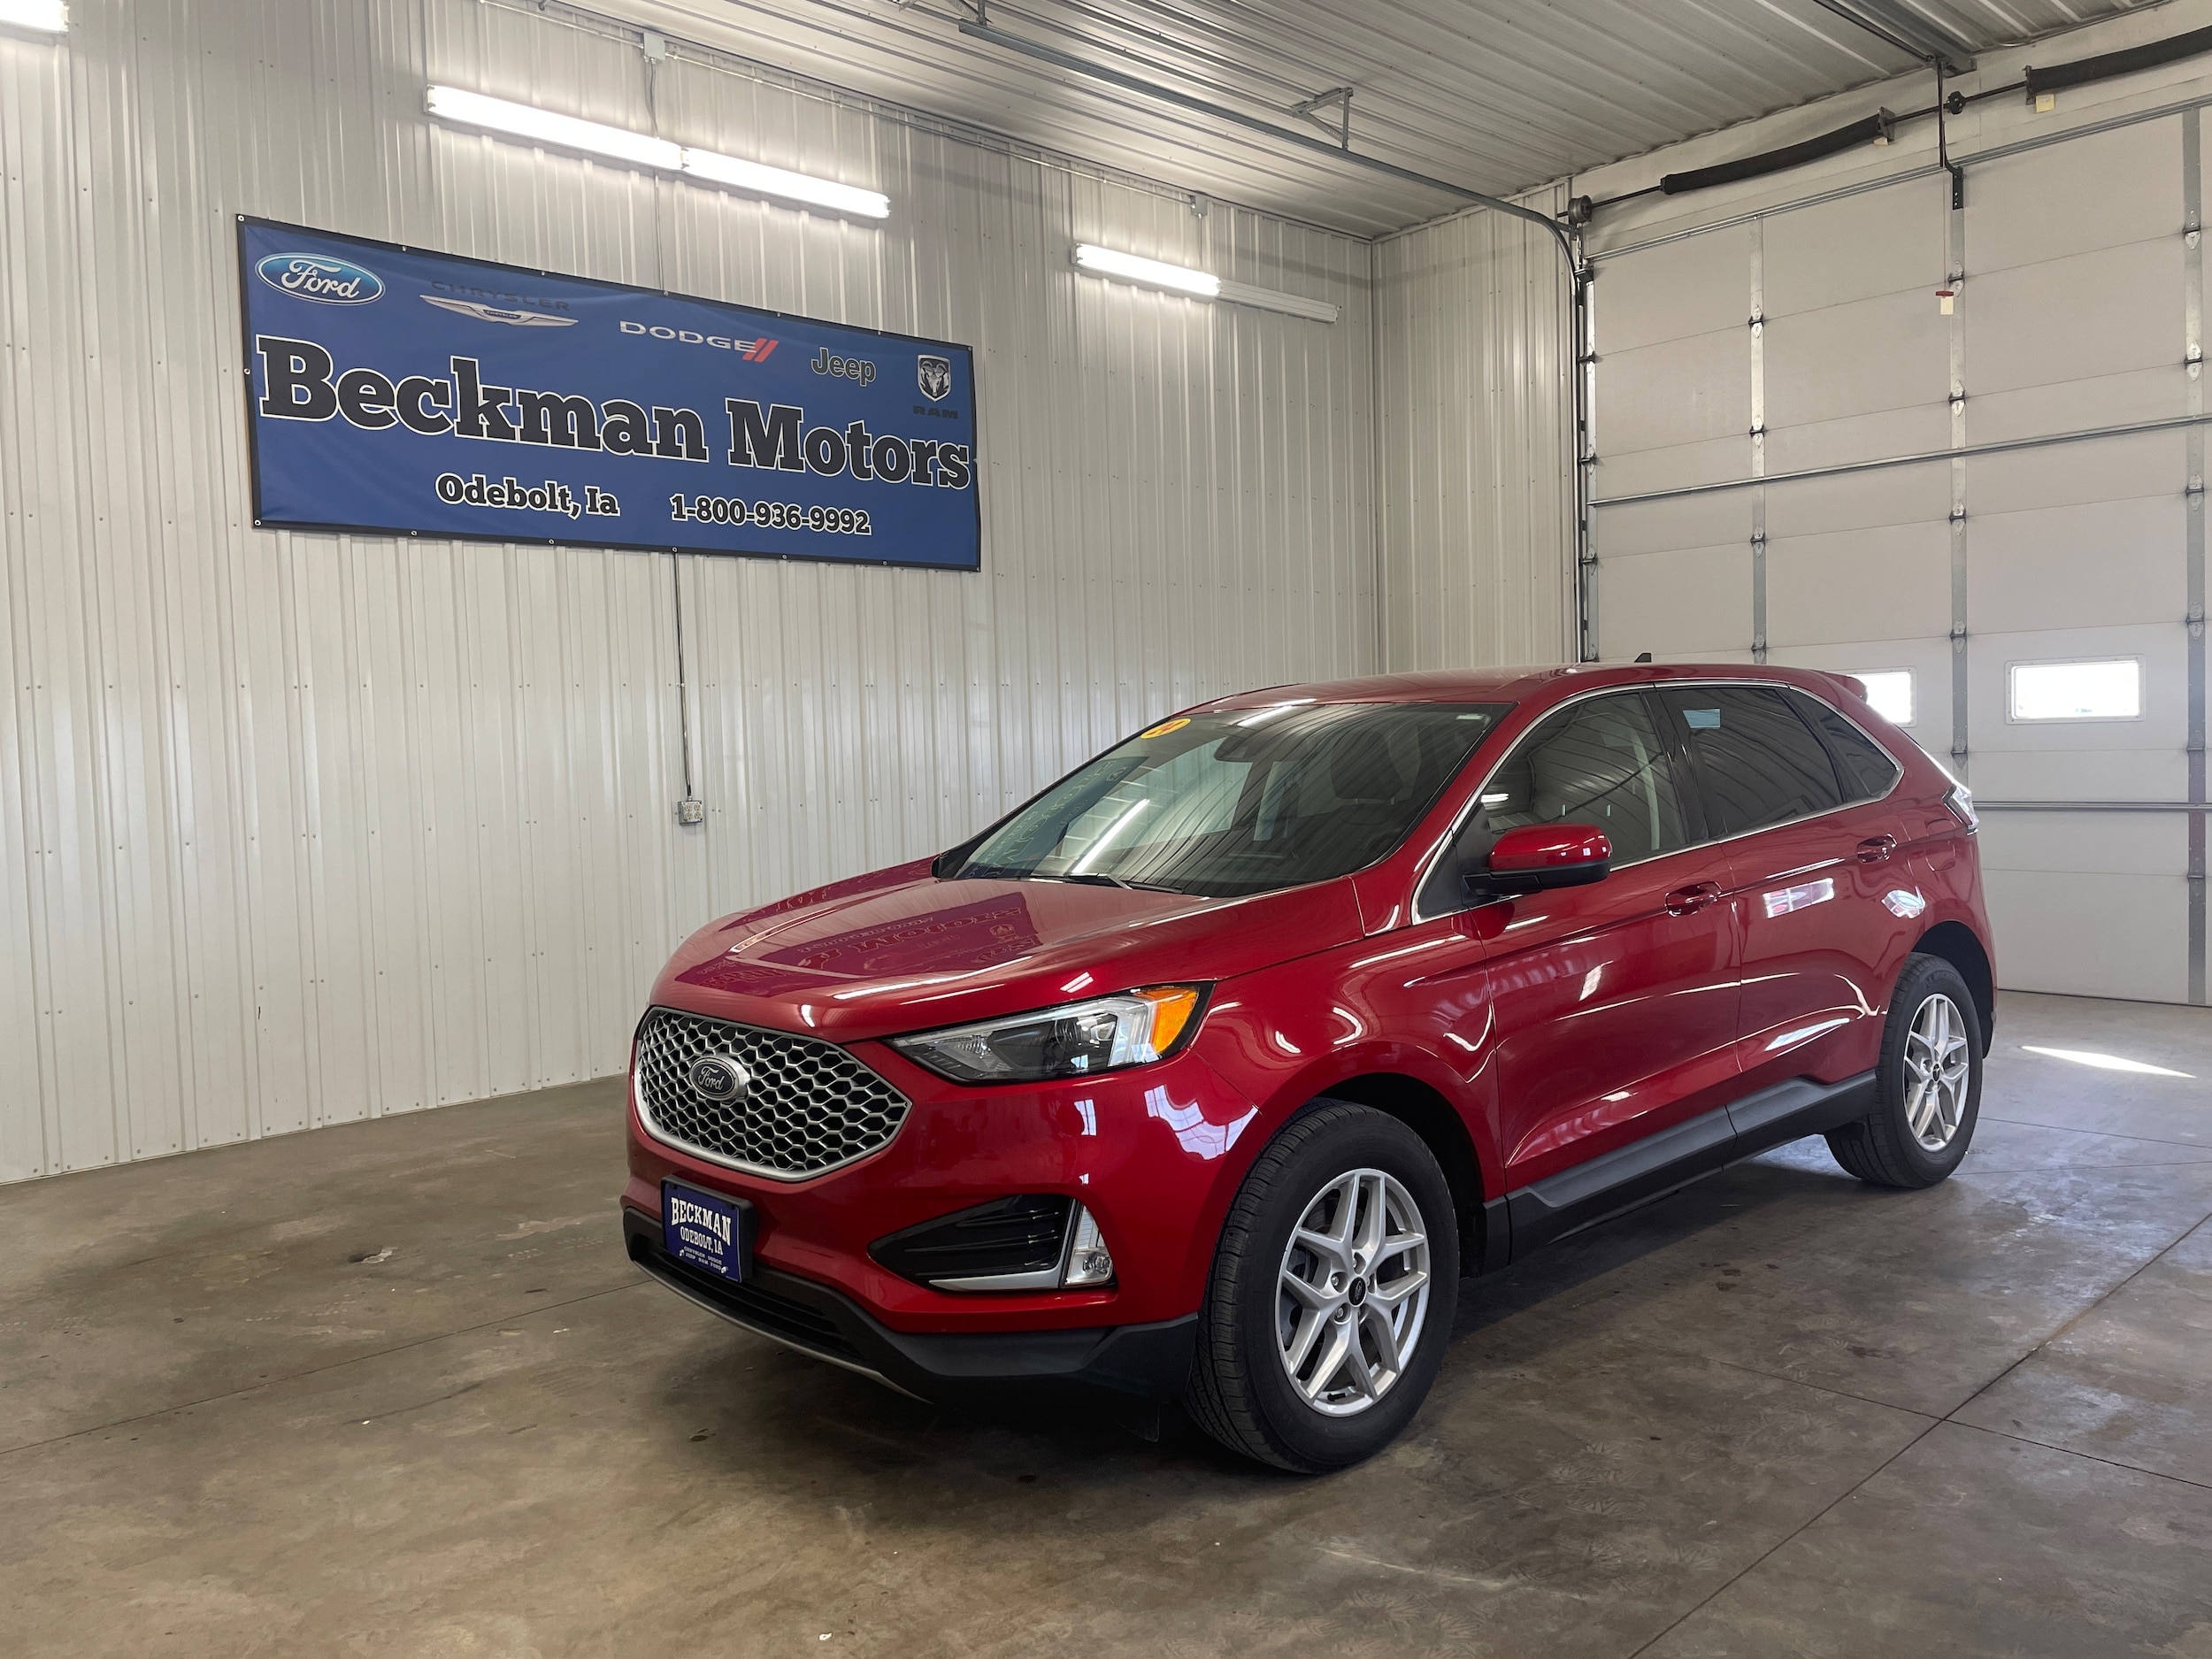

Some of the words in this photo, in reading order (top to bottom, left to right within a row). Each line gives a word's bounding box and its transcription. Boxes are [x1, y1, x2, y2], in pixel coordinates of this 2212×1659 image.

[281, 259, 359, 300] Ford
[431, 280, 571, 311] CHRYSLER
[619, 320, 758, 352] DODGE
[810, 347, 877, 387] Jeep
[255, 334, 710, 463] Beckman
[725, 396, 971, 490] Motors
[912, 404, 958, 419] RAM
[435, 472, 582, 520] Odebolt,
[585, 486, 620, 517] Ia
[669, 493, 872, 536] 1-800-936-9992
[697, 1065, 726, 1091] Ford
[671, 1197, 731, 1246] BECKMAN
[680, 1226, 713, 1253] ODEBOLT,
[714, 1240, 723, 1255] IA
